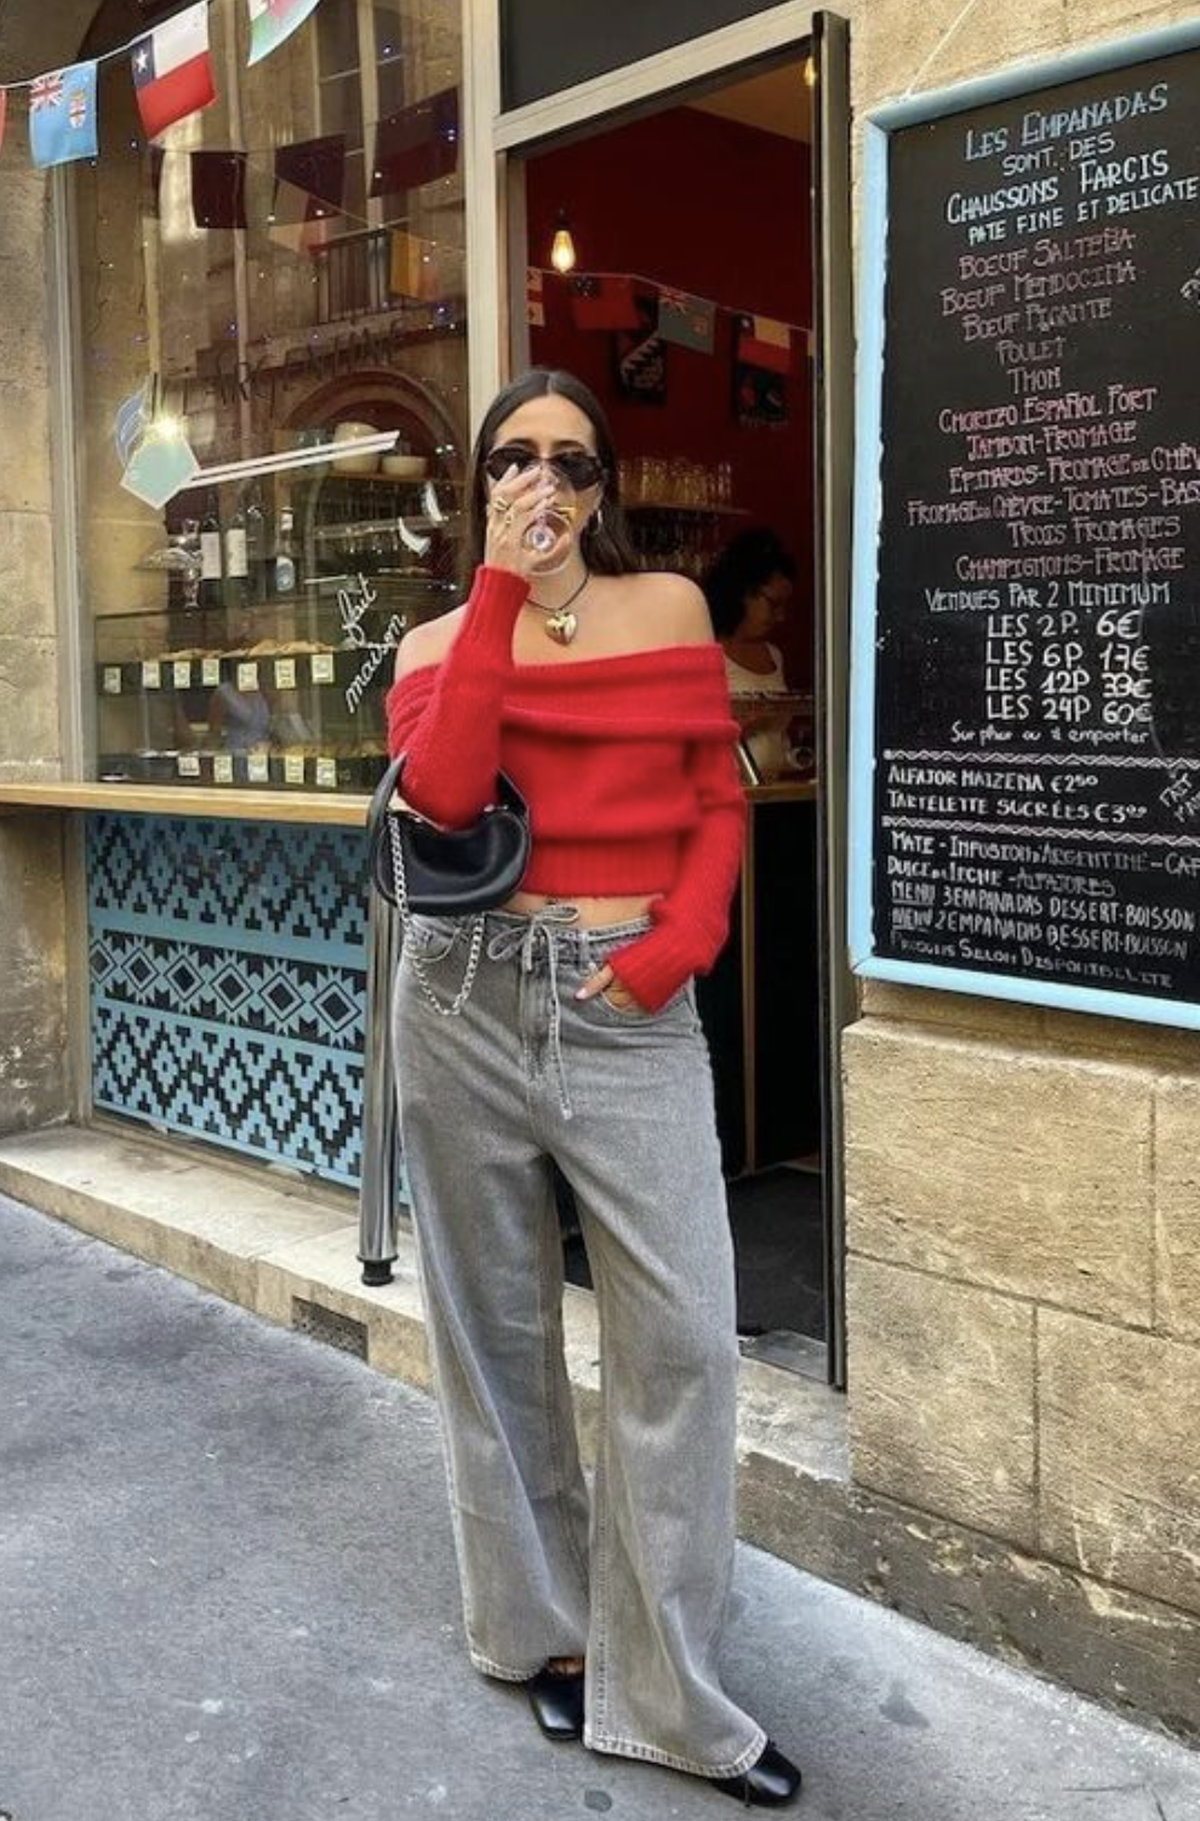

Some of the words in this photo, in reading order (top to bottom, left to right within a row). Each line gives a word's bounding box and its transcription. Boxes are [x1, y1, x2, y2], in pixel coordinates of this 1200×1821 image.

[965, 127, 1008, 160] LES
[1022, 83, 1168, 146] EMPANADAS
[1002, 147, 1054, 175] SONT
[1070, 132, 1115, 160] DES
[947, 177, 1059, 224] CHAUSSONS
[1079, 150, 1169, 194] FARCIS
[1017, 208, 1063, 235] FINE
[1077, 199, 1099, 223] ET
[996, 337, 1066, 365] POULET
[1007, 367, 1061, 394] THON
[939, 405, 1017, 432] CHORIZO
[1022, 391, 1102, 424] ESPAÑOL
[1107, 384, 1157, 414] FORT
[1007, 521, 1067, 547] TROIS
[1072, 516, 1181, 544] FROMAGES
[926, 588, 1000, 612] VENDUES
[1008, 583, 1042, 608] PAR
[1046, 581, 1059, 608] 2
[1068, 581, 1171, 606] MINIMUM
[987, 614, 1029, 638] LES
[1096, 610, 1141, 638] 6€
[346, 614, 406, 713] maison
[985, 640, 1033, 665] LES
[1099, 642, 1150, 672] 17€
[985, 667, 1026, 691] LES
[986, 694, 1032, 720] LES
[1042, 696, 1092, 722] 24P
[1102, 701, 1153, 725] 60€
[1068, 727, 1149, 746] emporter
[887, 765, 957, 786] ALFAJOR
[961, 769, 1044, 792] MAIZENA
[888, 790, 989, 815] TARTELETTE
